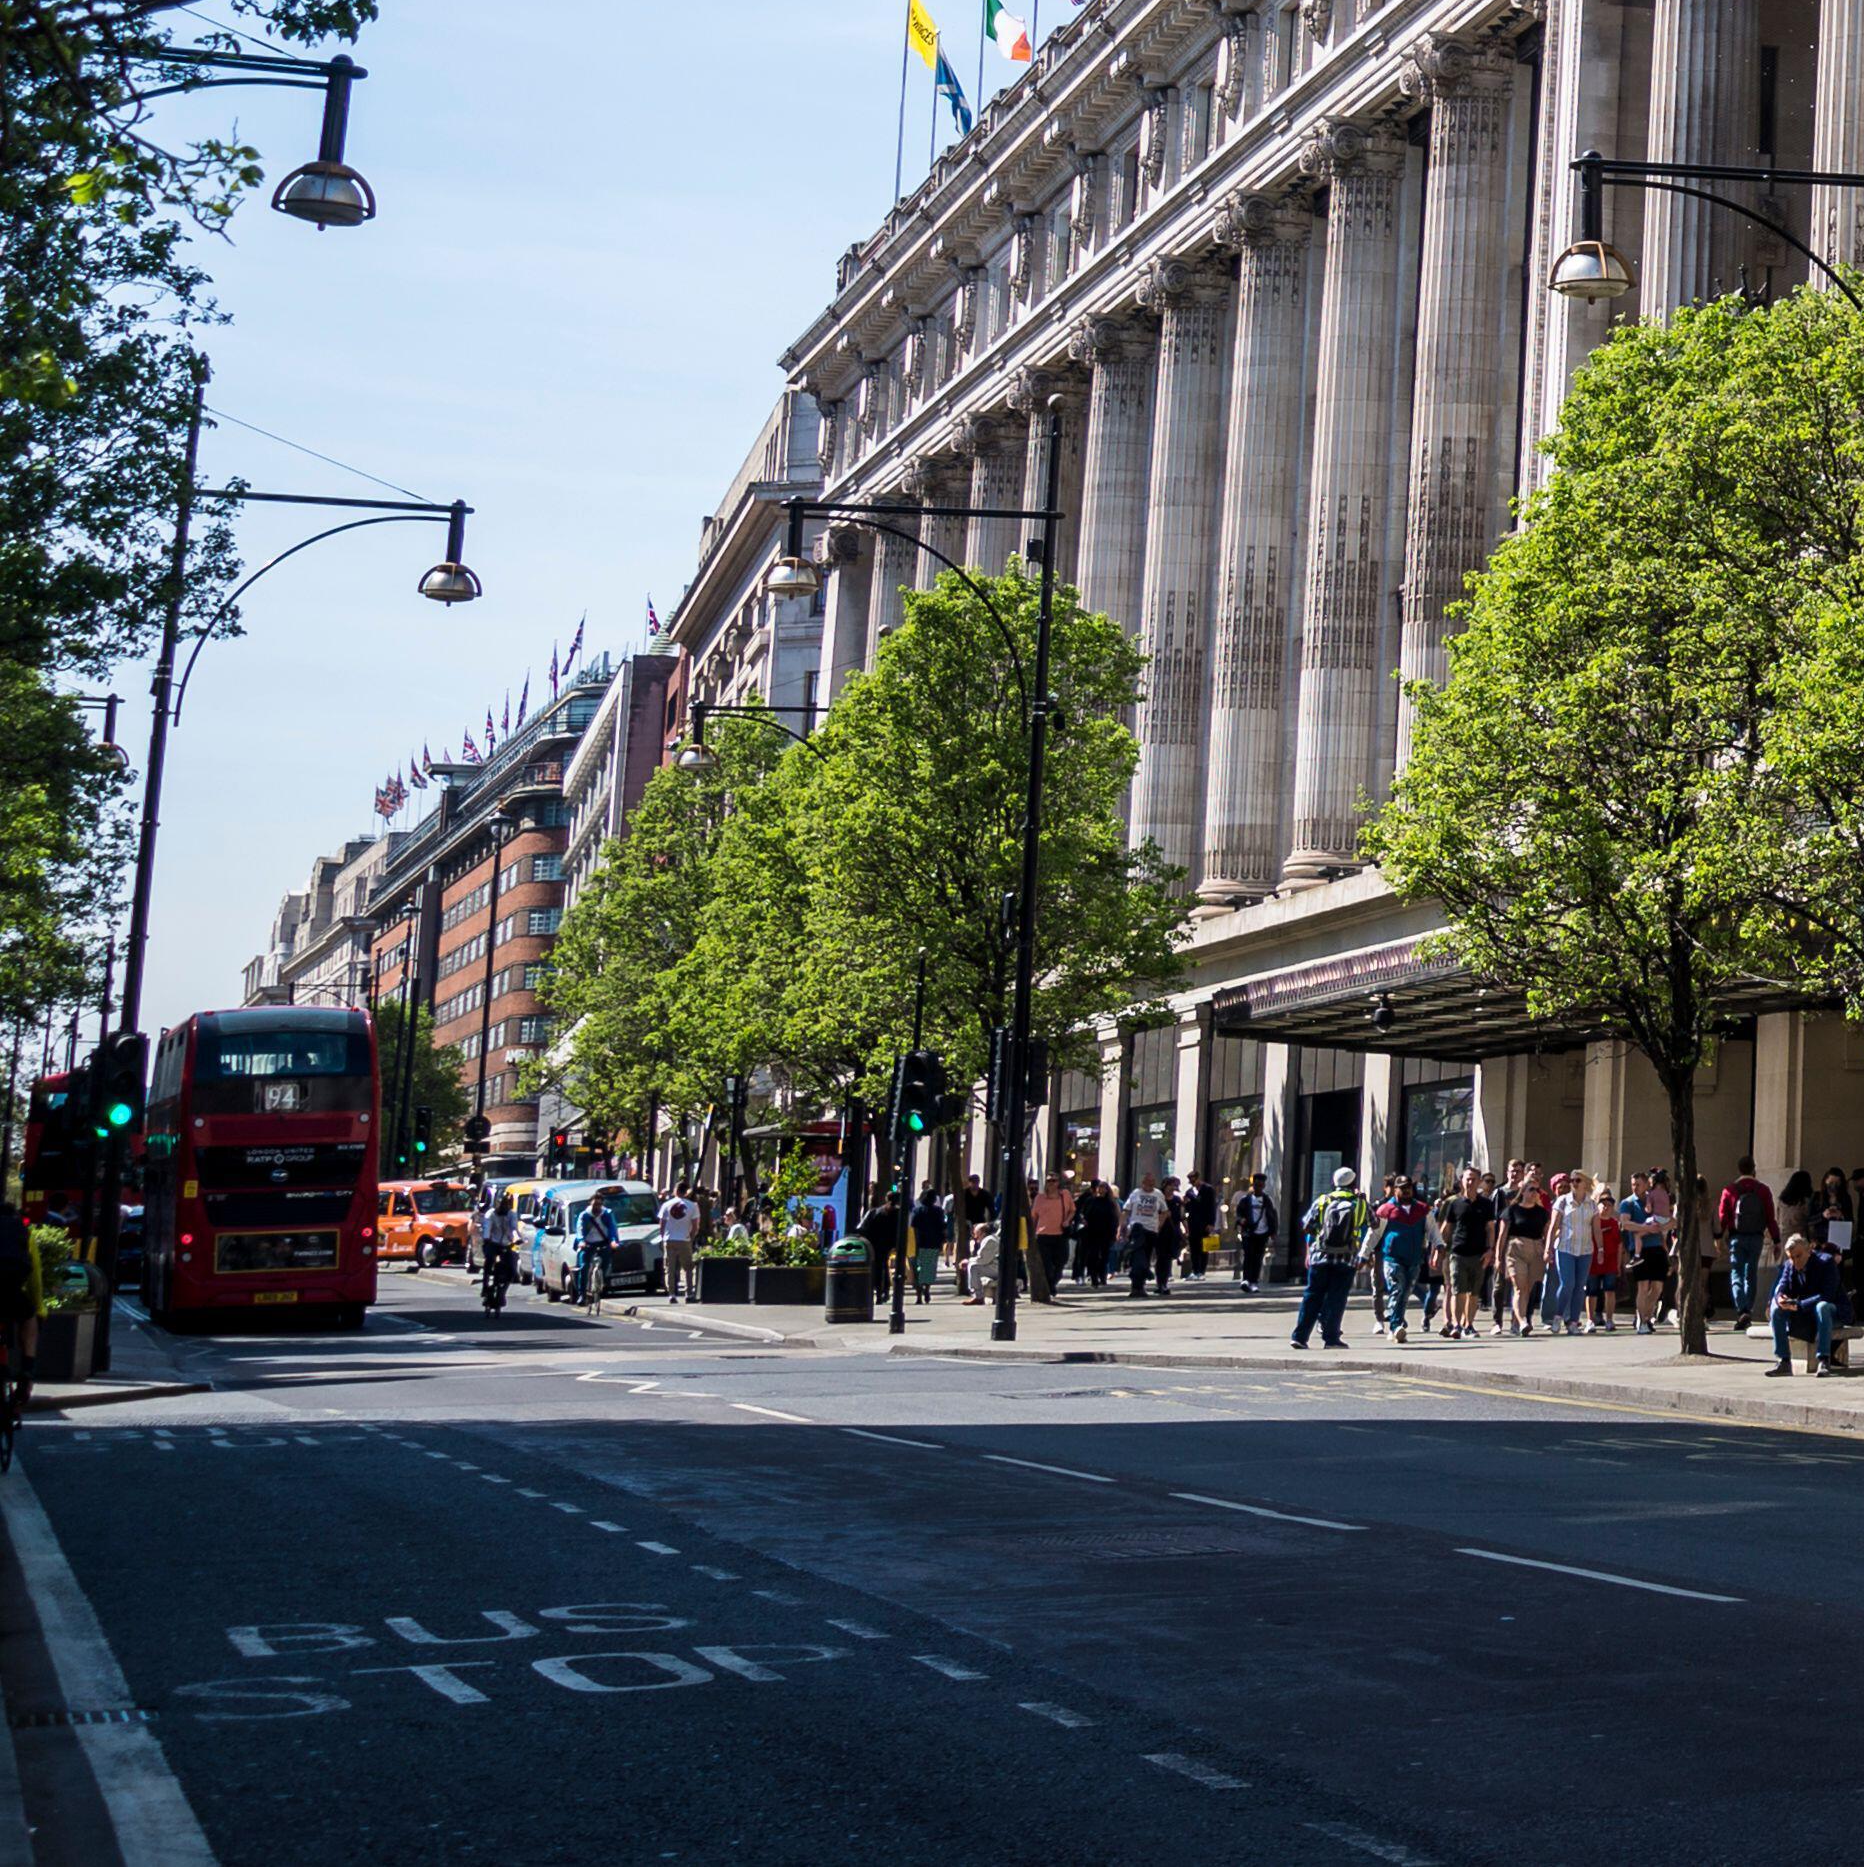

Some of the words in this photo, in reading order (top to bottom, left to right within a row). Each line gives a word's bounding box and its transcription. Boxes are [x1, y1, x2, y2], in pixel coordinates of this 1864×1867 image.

[267, 1085, 297, 1109] 94
[247, 1156, 272, 1164] RATP
[285, 1155, 316, 1163] GROUP
[226, 1602, 697, 1658] BUS
[173, 1643, 853, 1720] STOP
